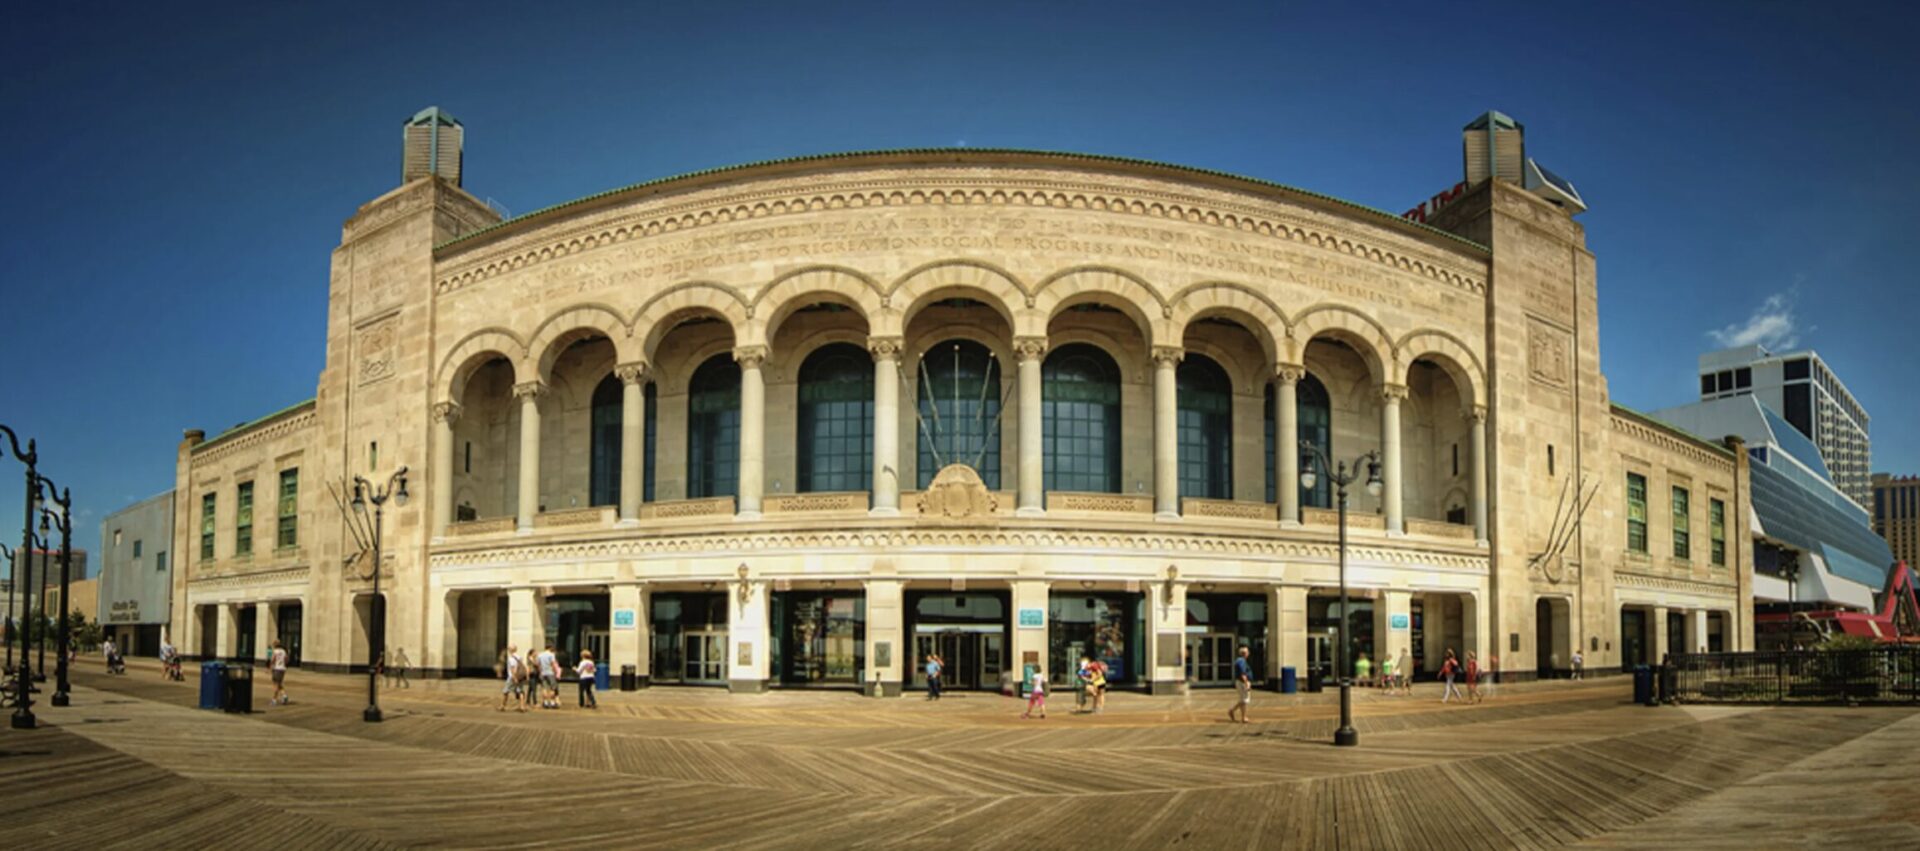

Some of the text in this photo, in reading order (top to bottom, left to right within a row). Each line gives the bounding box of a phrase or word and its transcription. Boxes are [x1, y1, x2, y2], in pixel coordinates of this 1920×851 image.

[854, 219, 880, 234] AS
[885, 217, 900, 231] A
[1193, 235, 1283, 262] ATLANTIC
[621, 266, 655, 283] AND
[662, 249, 761, 276] DEDICATED
[765, 244, 792, 258] TO
[931, 235, 1003, 249] SOCIAL
[1012, 236, 1114, 256] PROGRESS
[1120, 244, 1161, 260] AND
[1167, 249, 1278, 280] INDUSTRIAL
[1286, 270, 1405, 308] ACHIEVEMENTS
